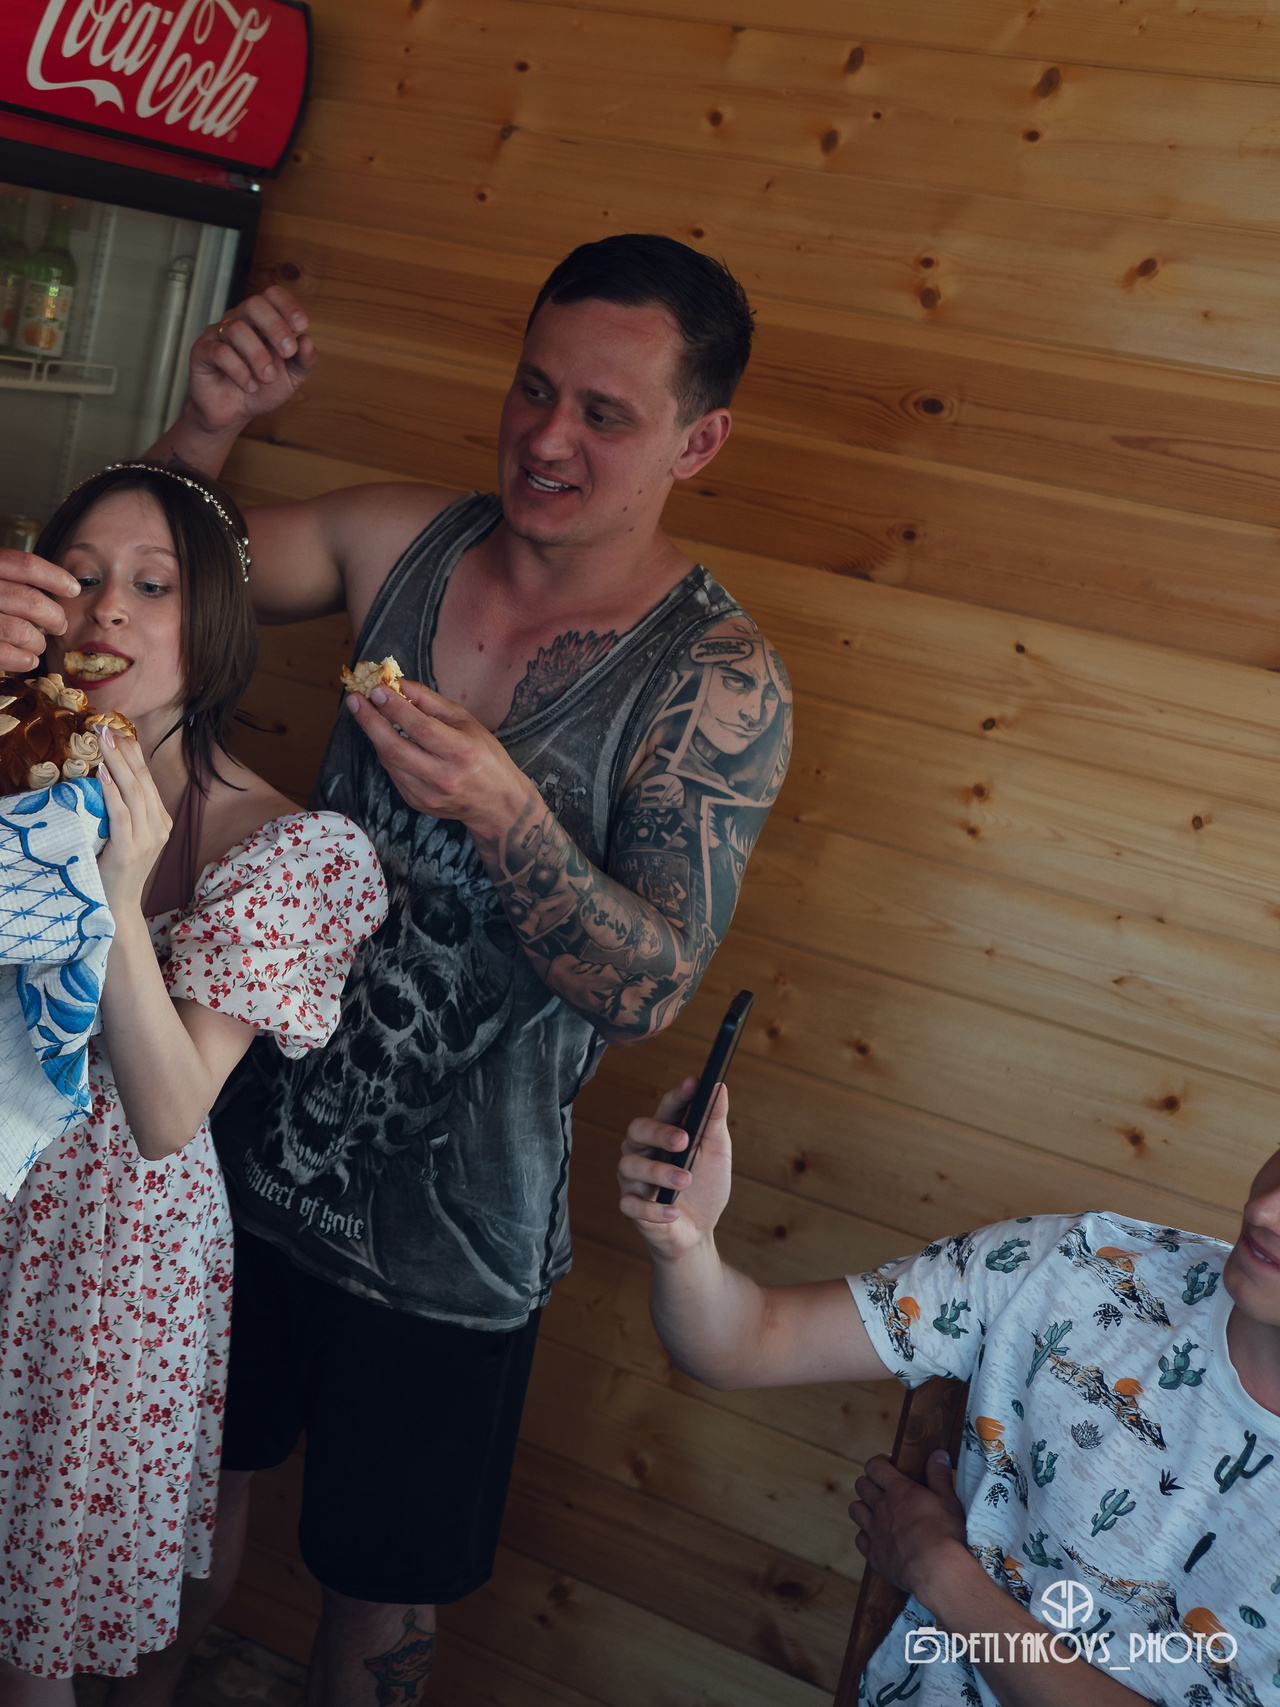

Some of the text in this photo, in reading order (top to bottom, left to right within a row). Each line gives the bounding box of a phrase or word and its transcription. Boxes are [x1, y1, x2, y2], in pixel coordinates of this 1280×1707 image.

[26, 0, 272, 140] Coca-Cola
[242, 1147, 366, 1240] hitect of hate
